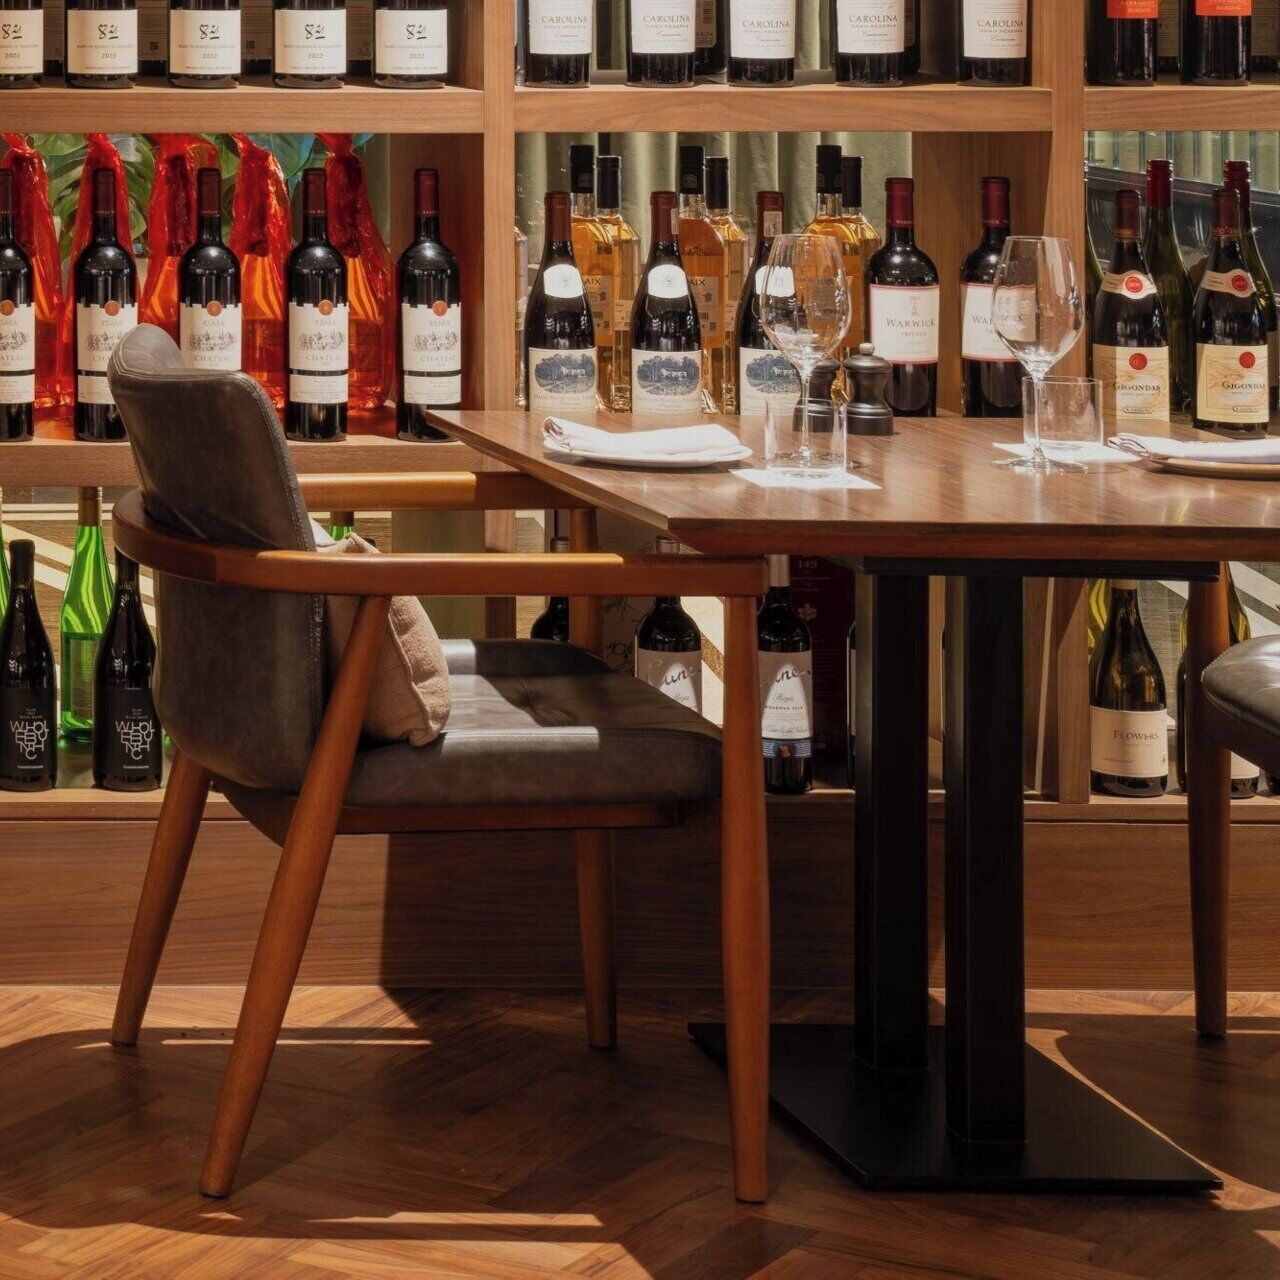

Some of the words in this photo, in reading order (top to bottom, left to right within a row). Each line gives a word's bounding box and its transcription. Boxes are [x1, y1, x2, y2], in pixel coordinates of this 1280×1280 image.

[542, 15, 587, 23] CAROLINA
[643, 15, 690, 23] CAROLINA
[849, 15, 898, 23] CAROLINA
[743, 19, 790, 28] CAROLINA
[977, 19, 1024, 28] CAROLINA
[585, 278, 601, 286] AIX
[688, 278, 706, 286] AIX
[886, 319, 935, 327] WARWICK
[1113, 382, 1160, 392] GIGONDAS
[1222, 381, 1266, 390] GIGONDAS
[1114, 731, 1158, 740] FLOWERS
